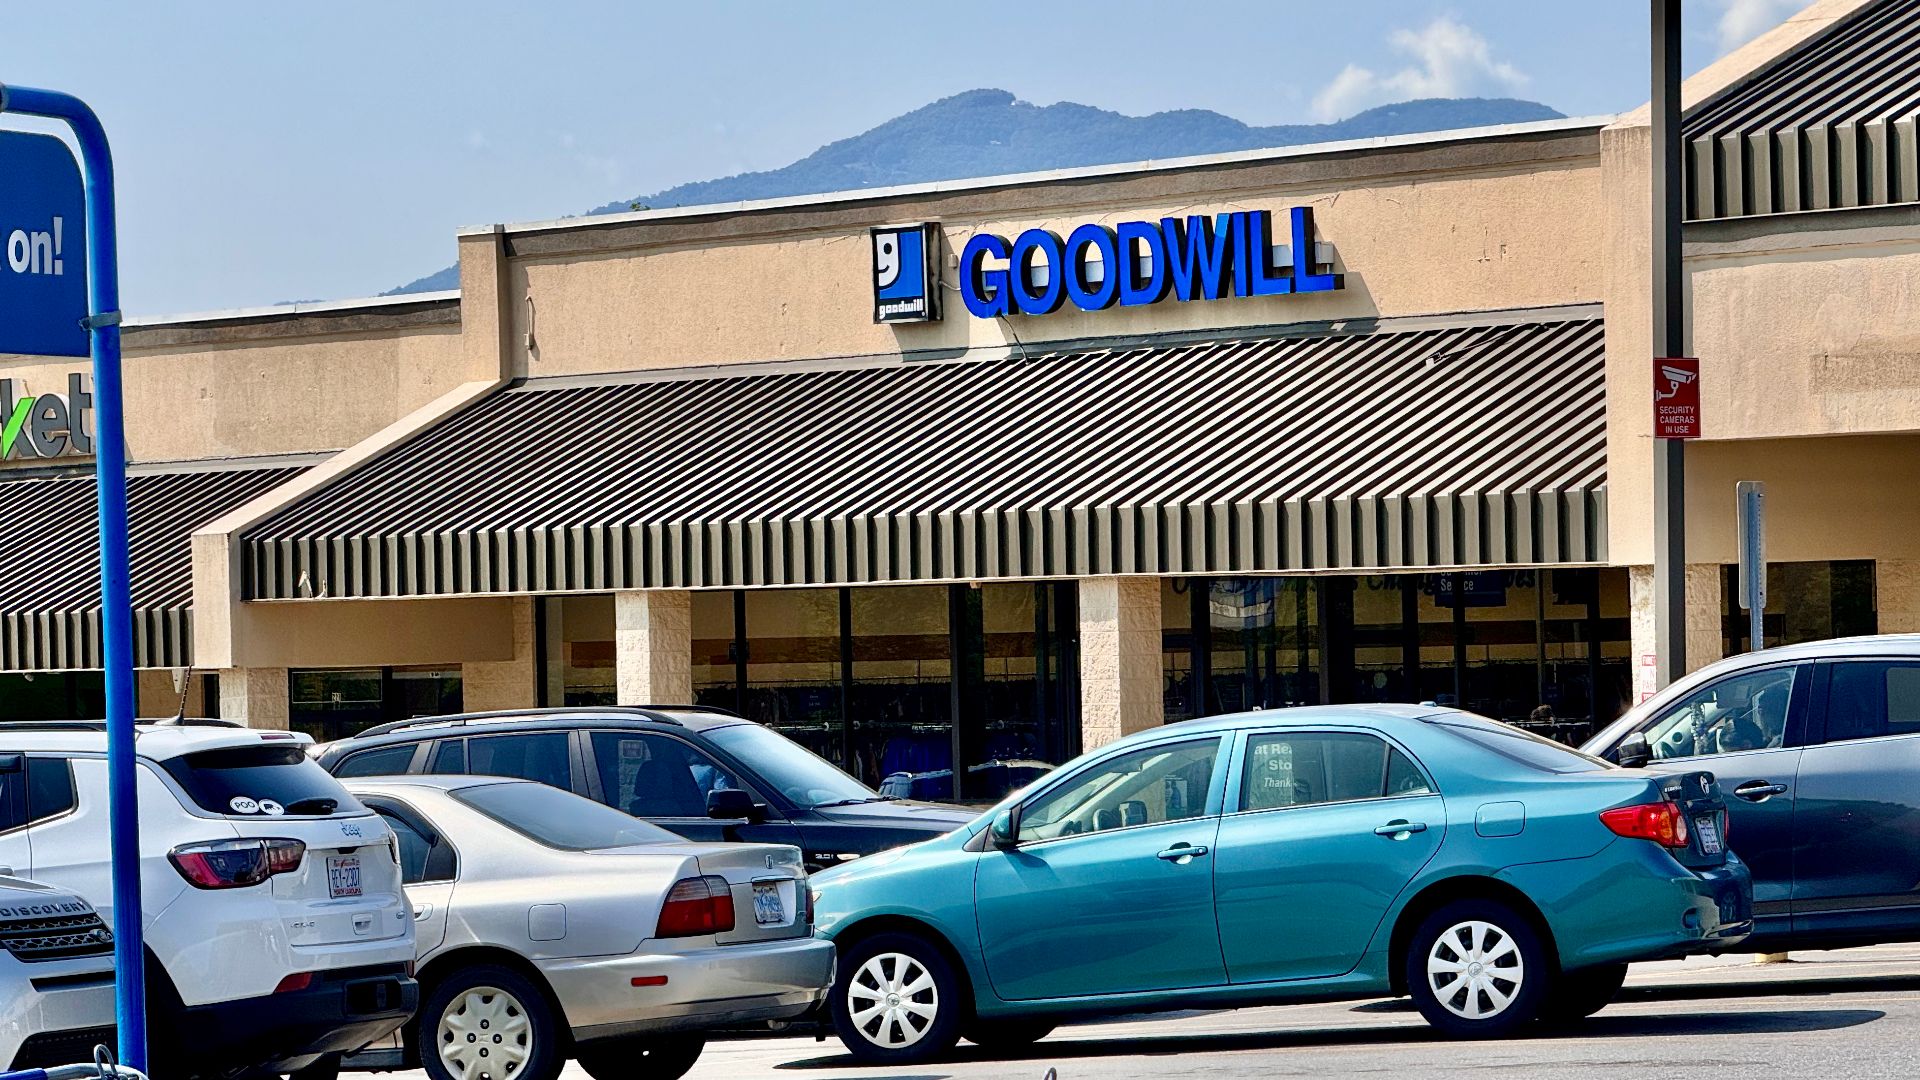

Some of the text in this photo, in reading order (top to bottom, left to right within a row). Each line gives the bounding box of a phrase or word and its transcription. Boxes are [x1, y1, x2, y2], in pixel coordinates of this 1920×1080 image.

[8, 216, 63, 275] on!
[960, 206, 1342, 319] GOODWILL
[879, 298, 924, 320] goodwill
[0, 372, 92, 460] ket
[1659, 405, 1695, 414] SECURITY
[1660, 415, 1695, 424] CAMERAS
[1665, 425, 1690, 434] IN USE
[0, 902, 87, 917] DISCOVERY
